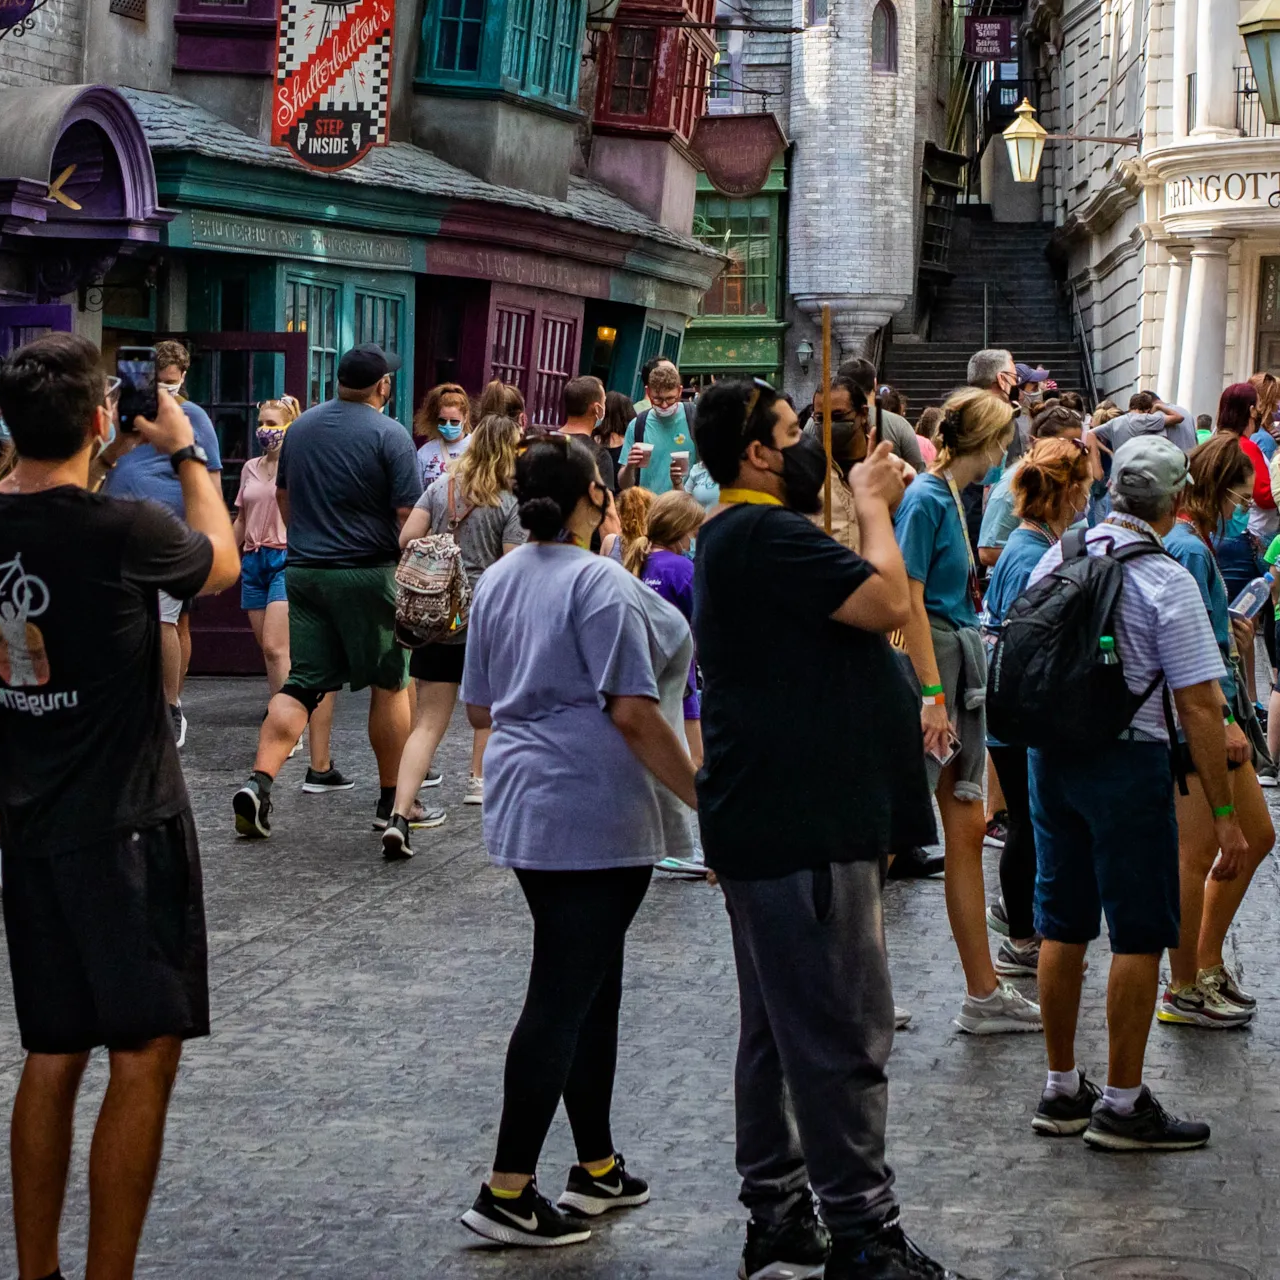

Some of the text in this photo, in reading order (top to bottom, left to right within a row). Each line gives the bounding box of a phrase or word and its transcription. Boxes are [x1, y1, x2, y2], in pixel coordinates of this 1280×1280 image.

[276, 1, 391, 128] Shutterbutton's
[314, 118, 345, 136] STEP
[308, 137, 349, 155] INSIDE
